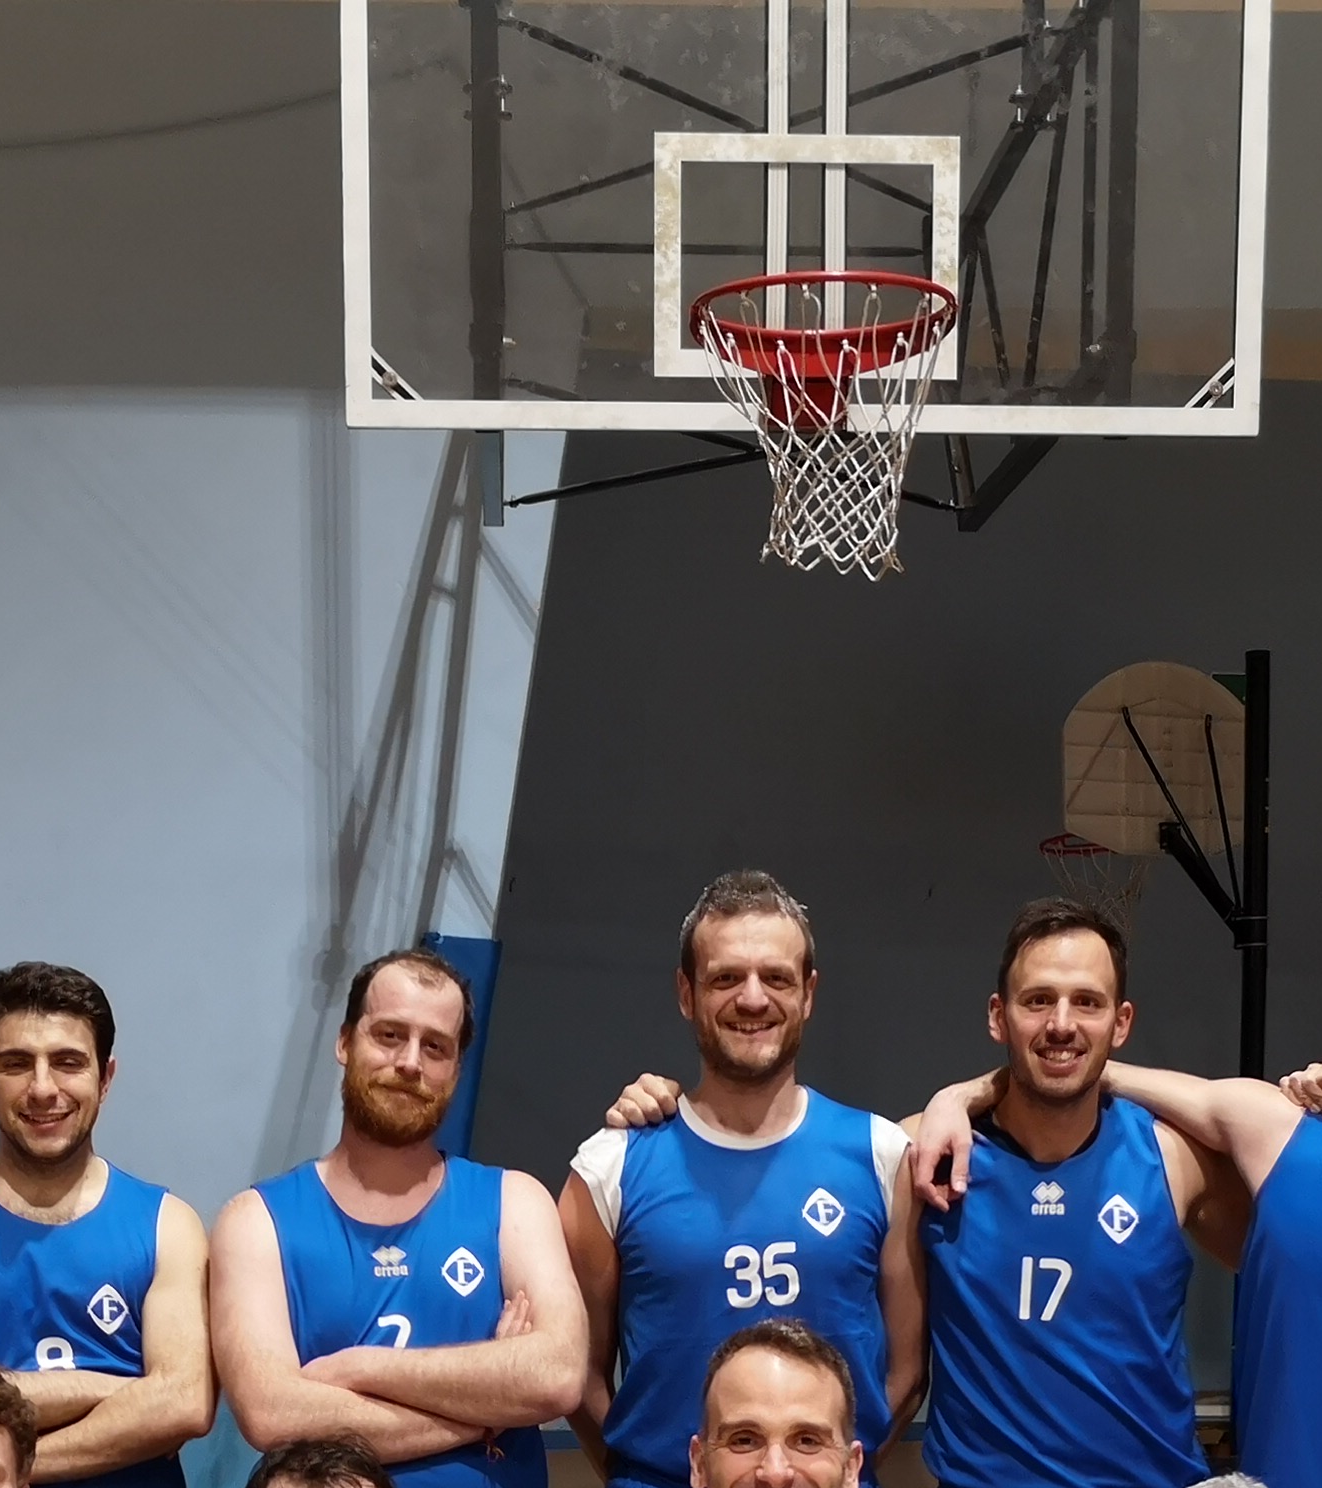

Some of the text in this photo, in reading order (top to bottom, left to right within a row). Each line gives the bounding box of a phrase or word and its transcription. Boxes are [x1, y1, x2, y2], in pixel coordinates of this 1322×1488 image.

[1031, 1201, 1065, 1216] errea
[724, 1241, 800, 1308] 35
[1018, 1256, 1073, 1322] 17
